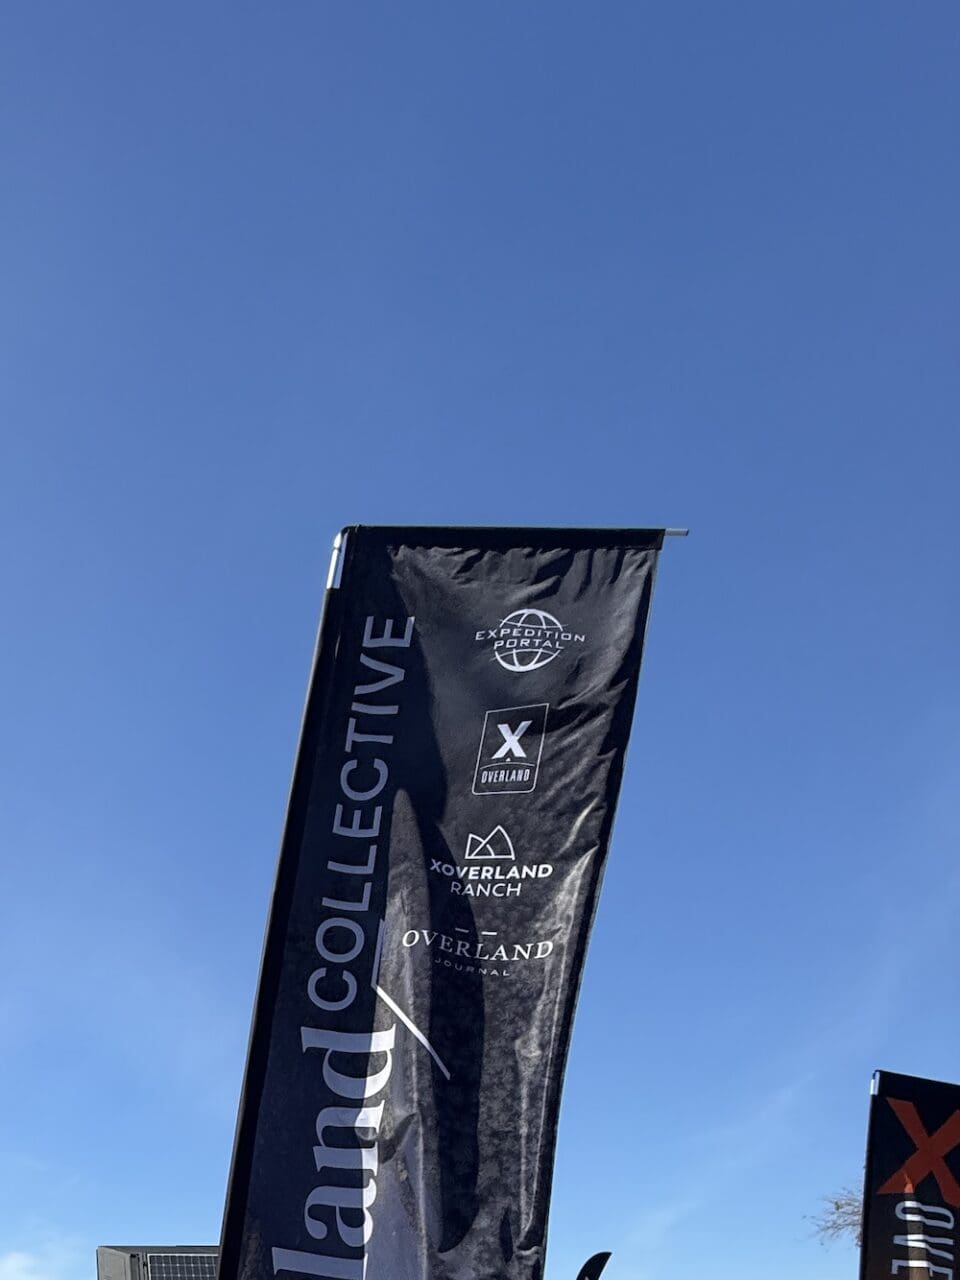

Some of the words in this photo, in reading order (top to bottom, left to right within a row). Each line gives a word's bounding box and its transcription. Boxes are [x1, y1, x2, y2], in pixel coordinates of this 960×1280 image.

[475, 628, 585, 642] EXPEDITION
[493, 638, 565, 650] PORTAL
[491, 720, 533, 760] X
[481, 768, 530, 784] OVERLAND
[306, 615, 415, 1012] COLLECTIVE
[430, 858, 554, 880] XOVERLAND
[450, 881, 522, 898] RANCH
[402, 929, 554, 961] OVERLAND
[434, 958, 511, 977] JOURNAL
